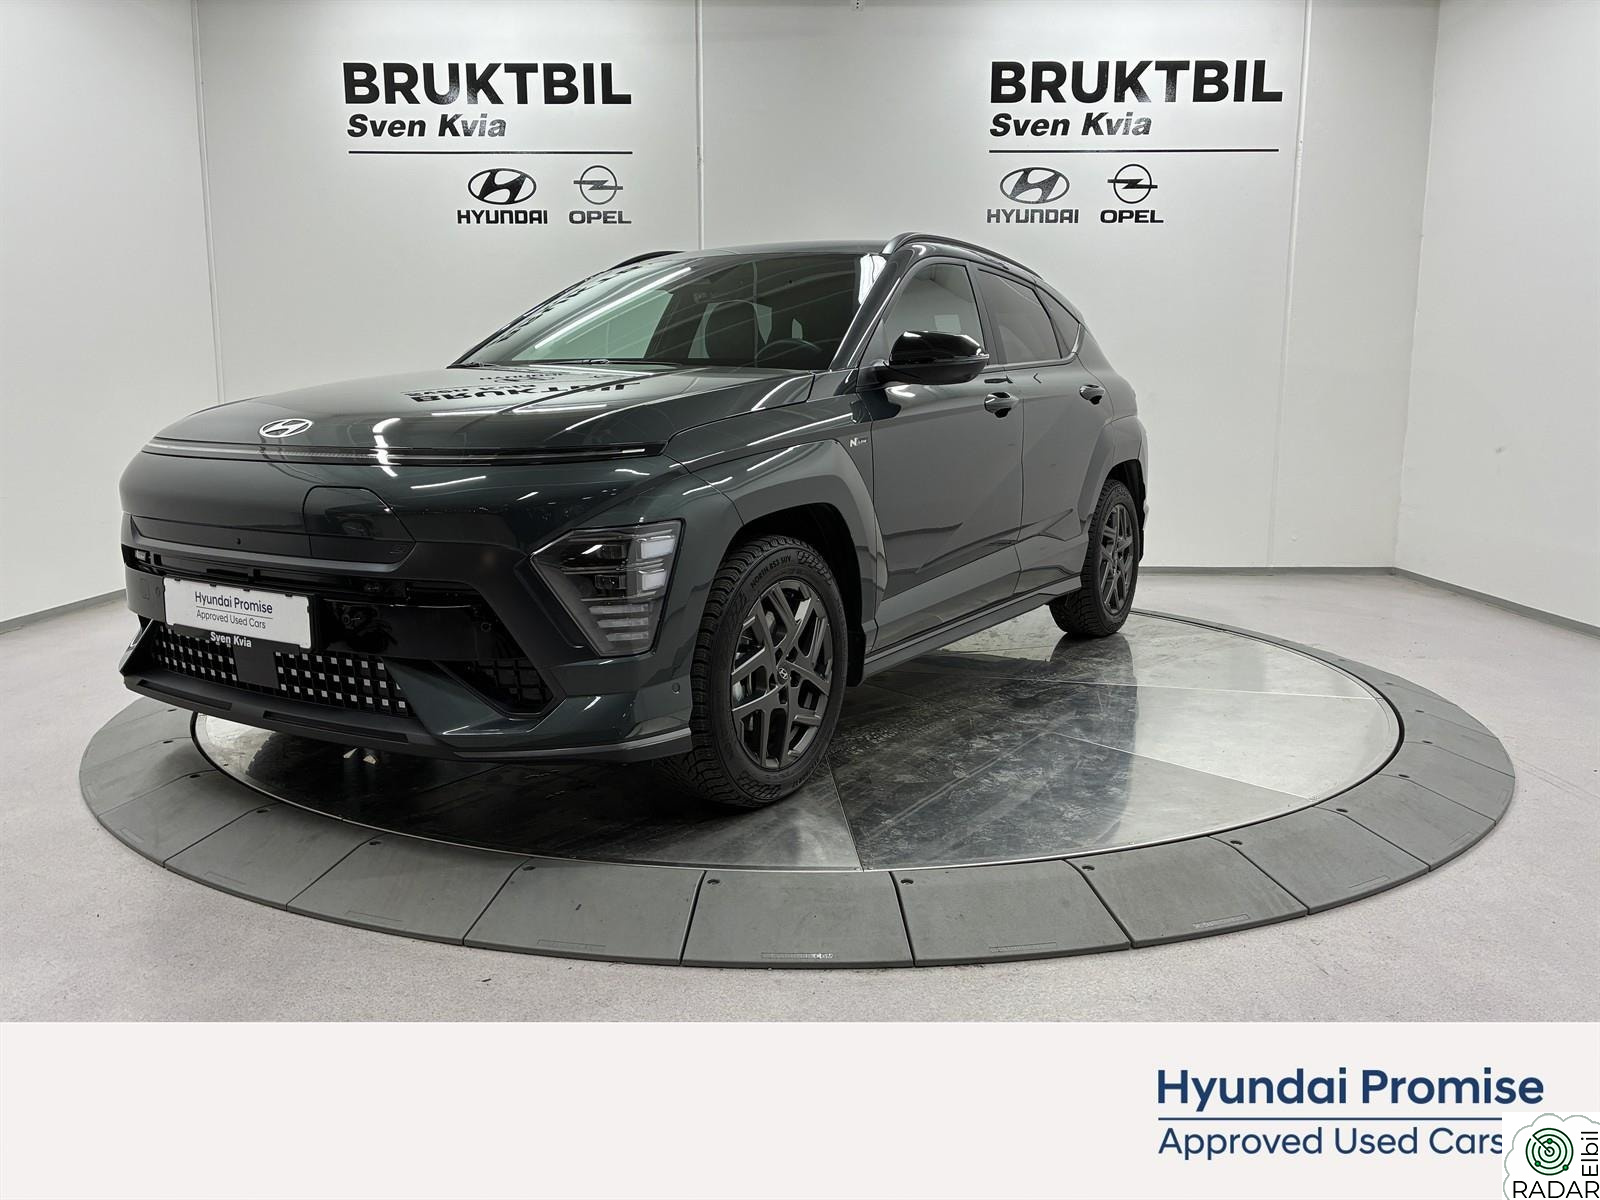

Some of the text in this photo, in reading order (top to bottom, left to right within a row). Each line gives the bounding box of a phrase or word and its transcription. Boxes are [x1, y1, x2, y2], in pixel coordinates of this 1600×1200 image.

[343, 62, 632, 105] BRUKTBIL
[990, 60, 1283, 103] BRUKTBIL
[347, 113, 507, 138] Sven Kvia
[989, 112, 1152, 137] Sven Kvia
[456, 209, 548, 225] HYUNDAI
[568, 210, 632, 225] OPEL
[986, 208, 1080, 224] HYUNDAI
[1099, 209, 1165, 224] OPEL
[195, 591, 273, 614] Hyundai Promise
[196, 609, 266, 629] Approved Used Cars
[210, 632, 252, 648] Sven Kvia
